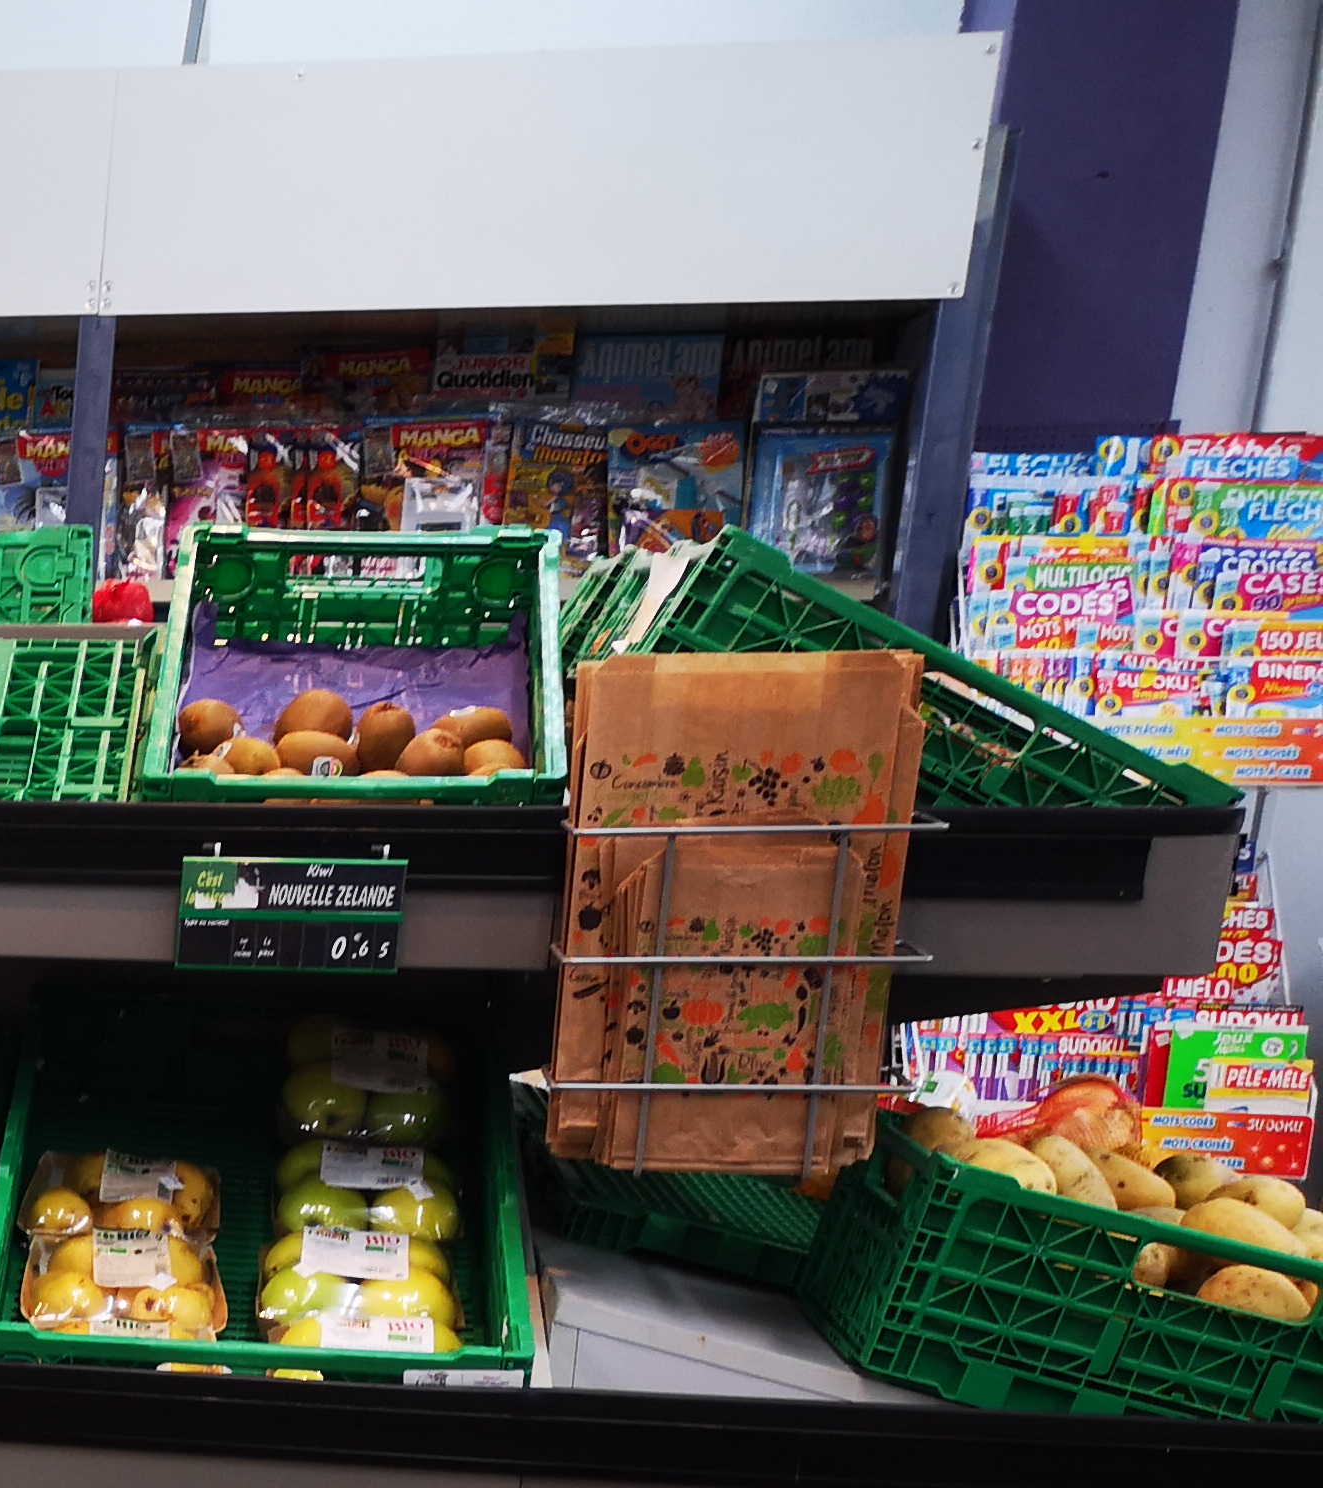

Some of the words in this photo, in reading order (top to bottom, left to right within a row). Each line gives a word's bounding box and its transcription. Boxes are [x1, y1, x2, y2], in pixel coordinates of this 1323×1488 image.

[437, 368, 534, 390] Quotidien
[400, 427, 480, 448] MANGA
[1191, 457, 1291, 478] FLÉCHÉS
[1016, 589, 1115, 616] CODÉS
[1260, 632, 1293, 650] 150
[1117, 672, 1191, 689] SUOKU
[306, 863, 335, 878] Kiwi
[268, 883, 335, 908] NOUVELLE
[335, 884, 396, 908] ZELANDE
[1013, 1010, 1081, 1034] XXL
[1058, 1037, 1124, 1054] SUDOKU
[1153, 1116, 1180, 1126] MOTS
[1163, 1138, 1189, 1149] MOTS
